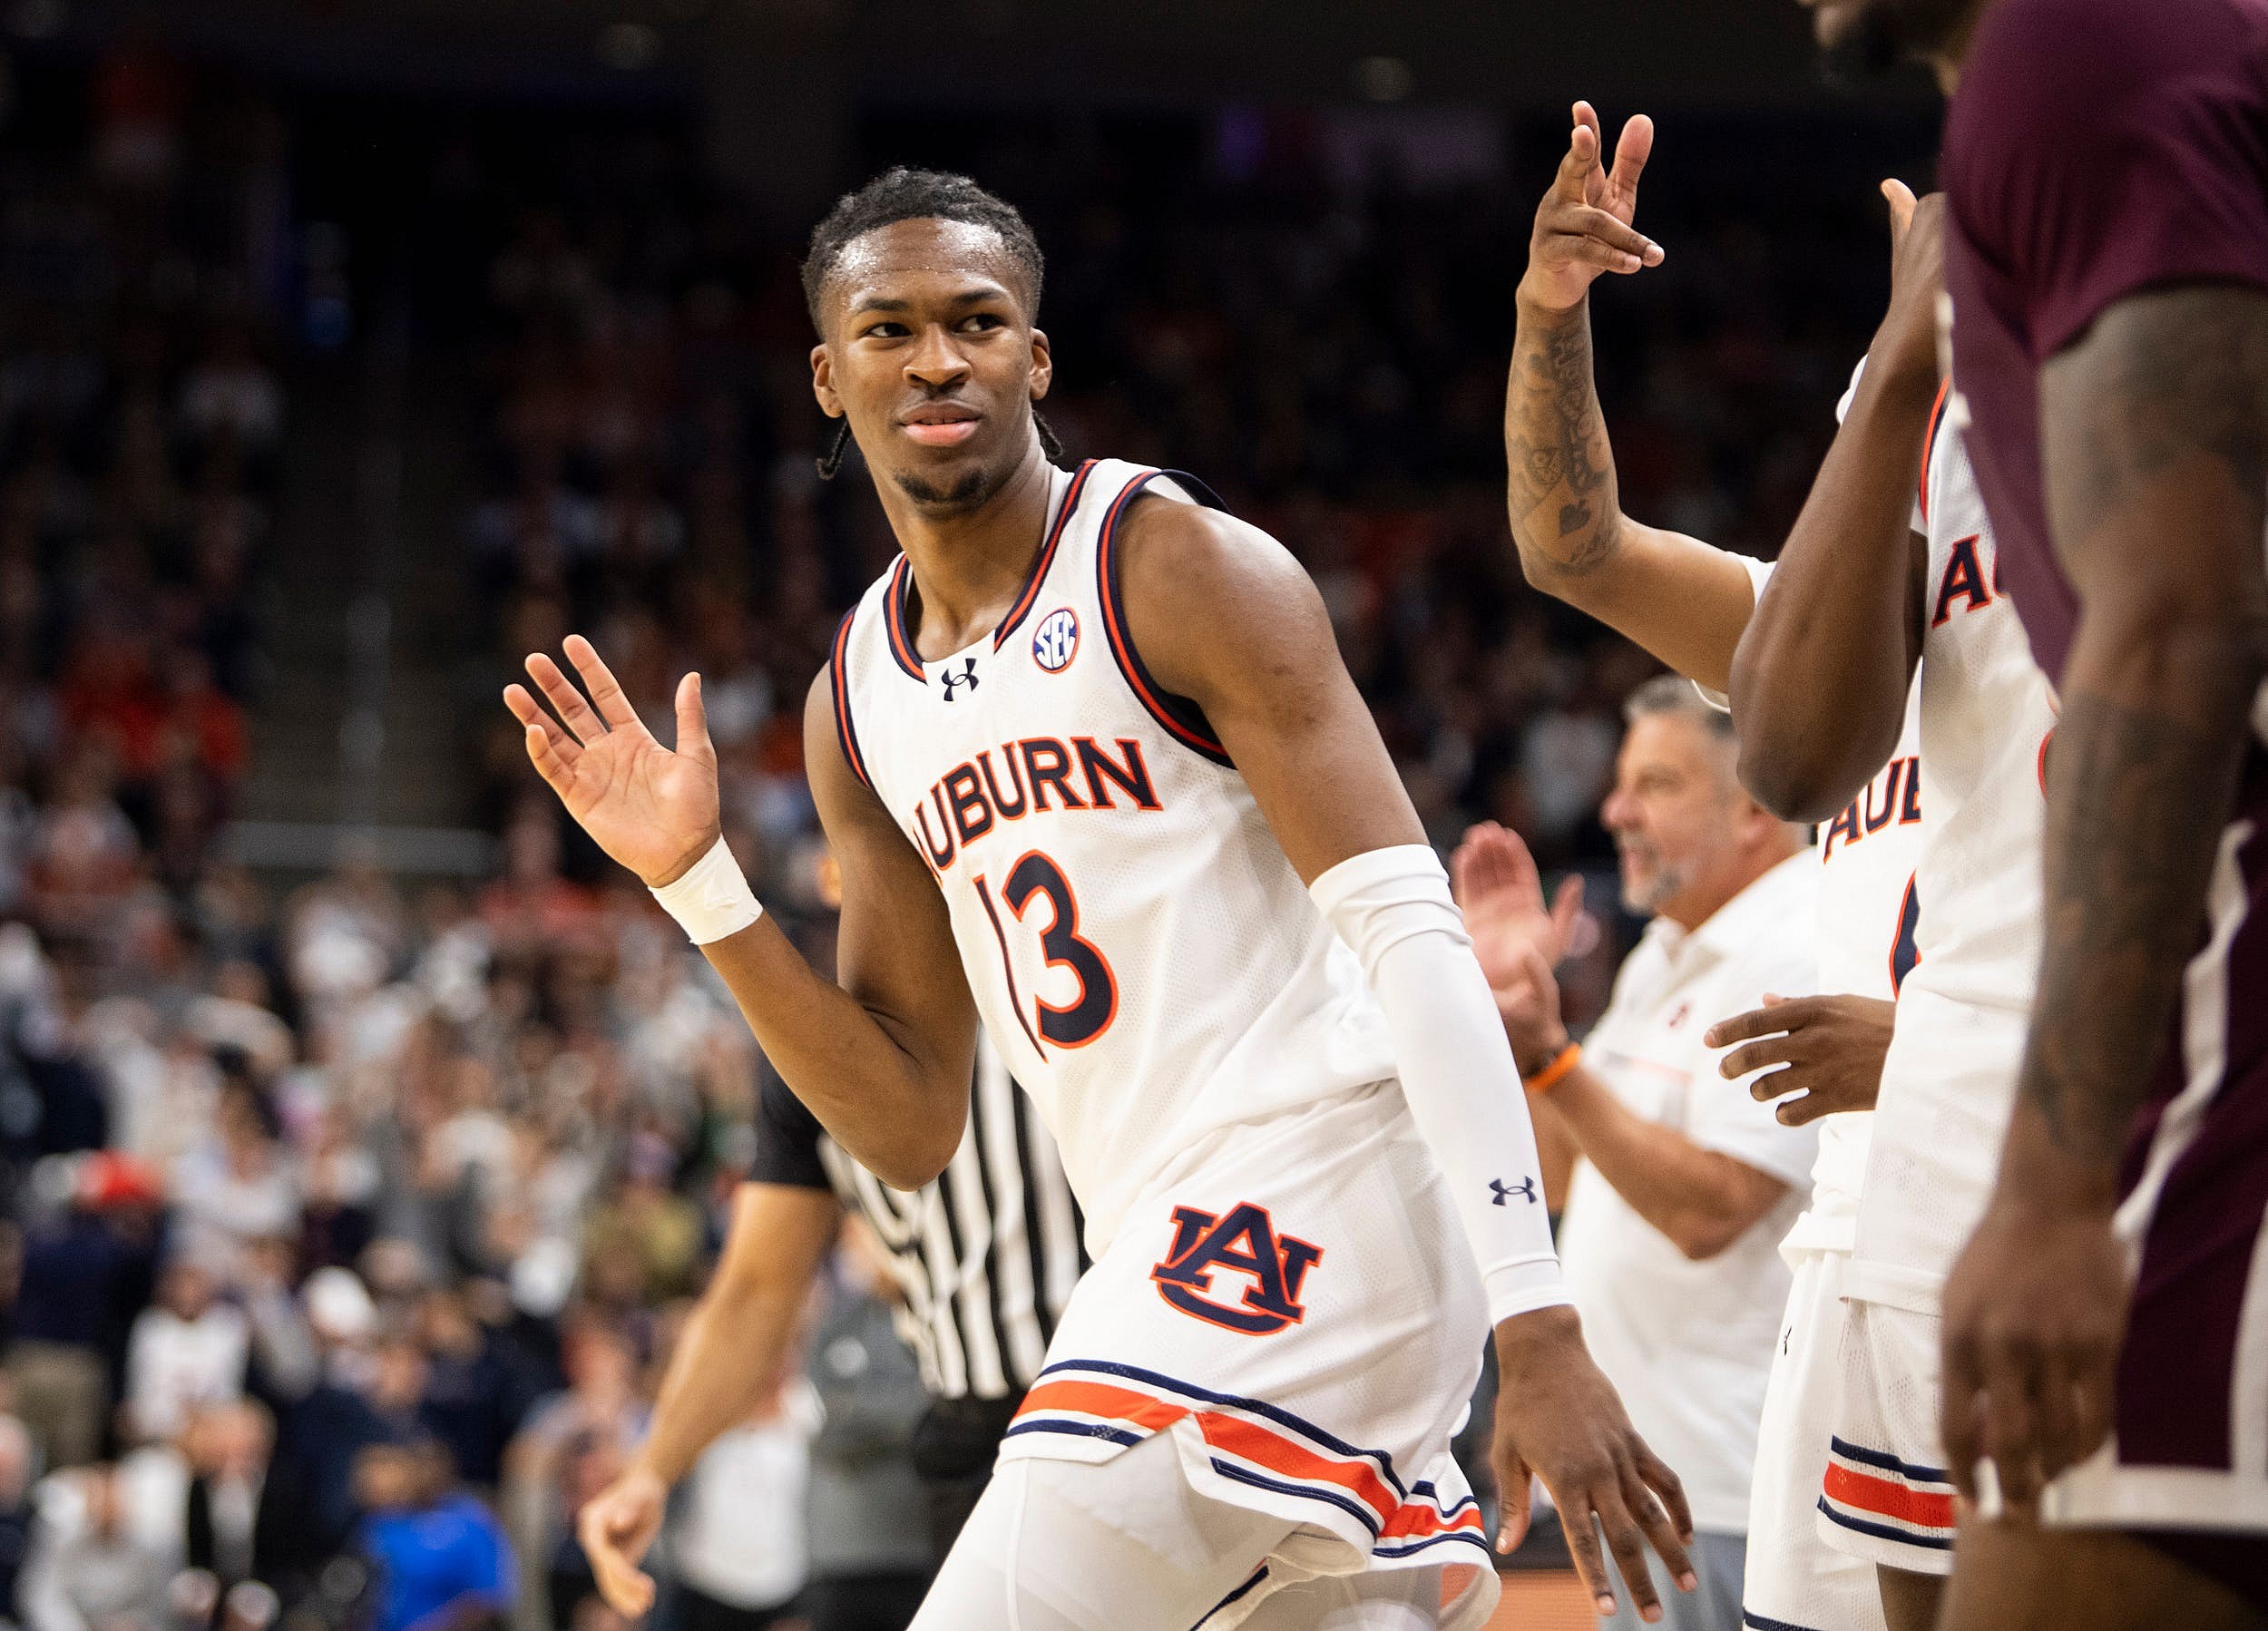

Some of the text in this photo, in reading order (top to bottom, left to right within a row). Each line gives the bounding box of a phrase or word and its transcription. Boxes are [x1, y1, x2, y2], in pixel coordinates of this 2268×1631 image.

[1931, 533, 2009, 630] A
[1033, 609, 1079, 672] SEC
[912, 736, 1165, 889] UBURN
[1149, 1200, 1325, 1337] AU
